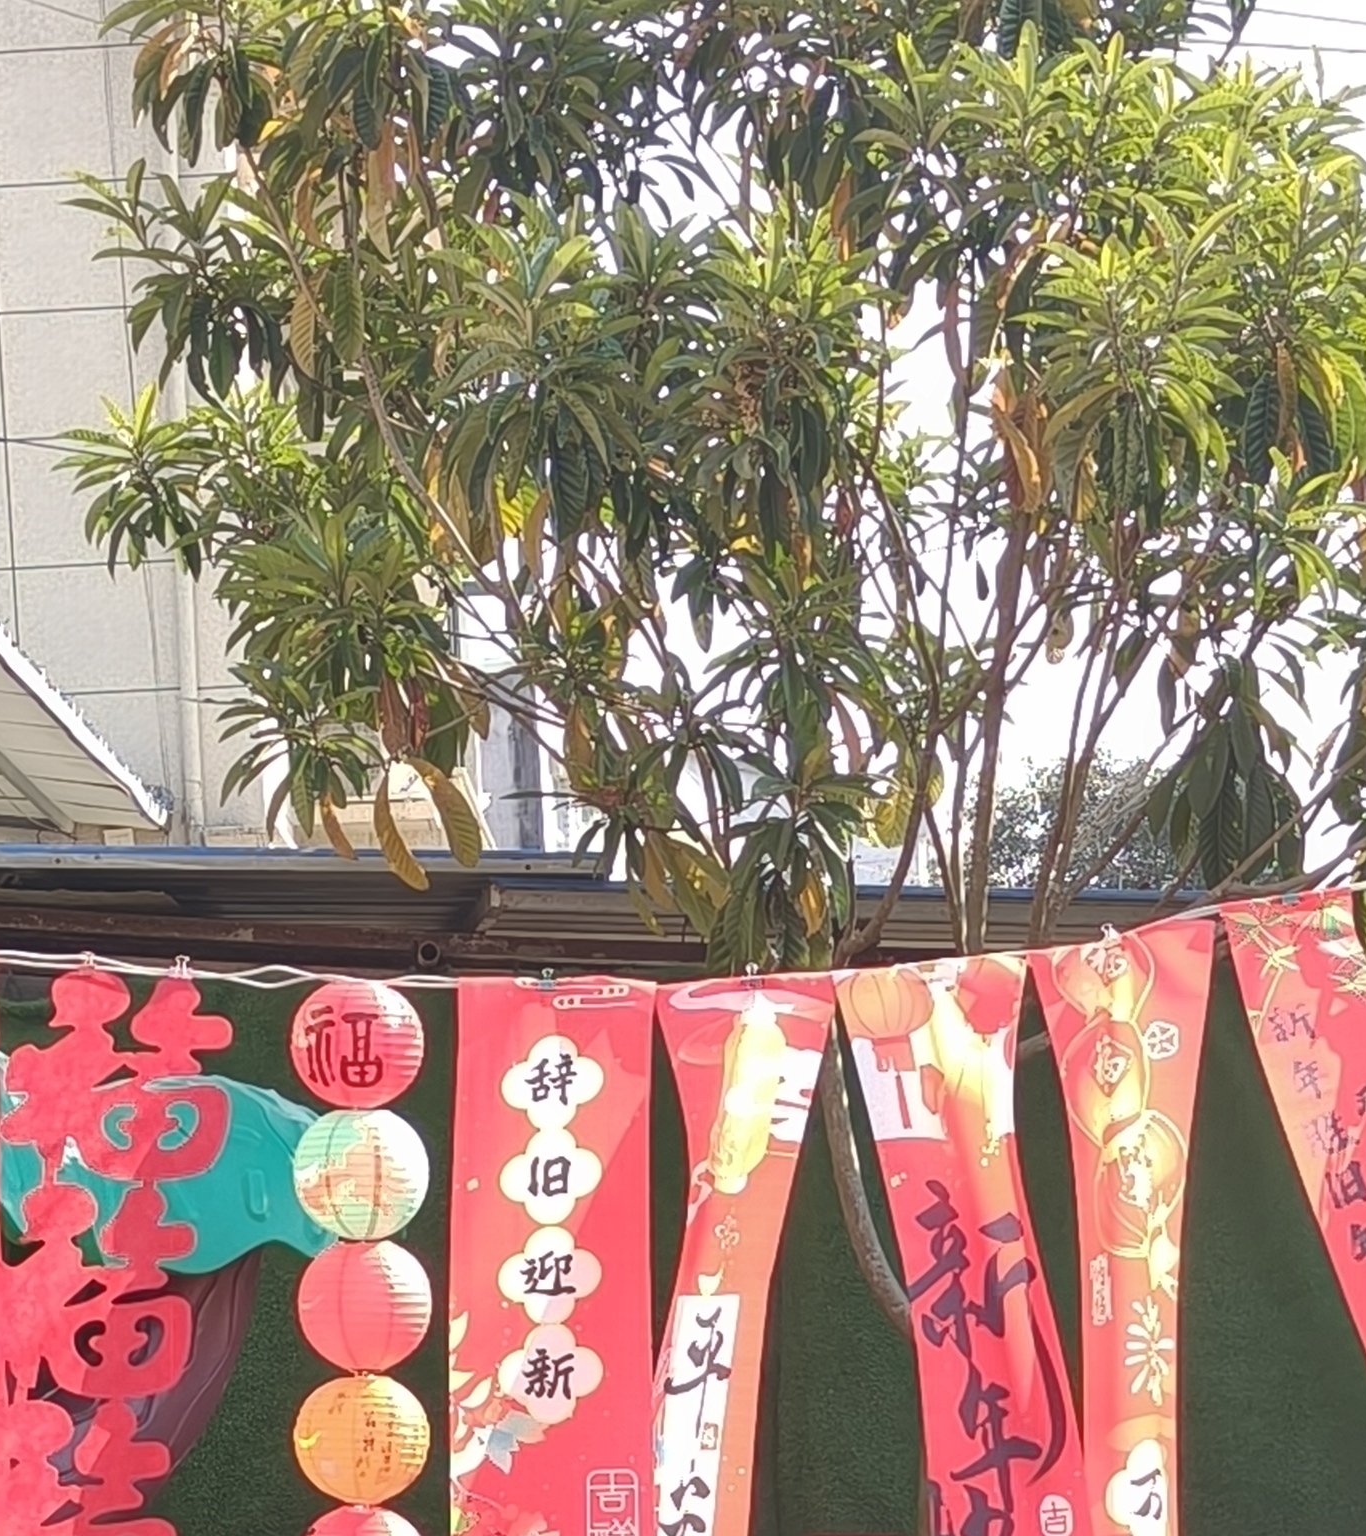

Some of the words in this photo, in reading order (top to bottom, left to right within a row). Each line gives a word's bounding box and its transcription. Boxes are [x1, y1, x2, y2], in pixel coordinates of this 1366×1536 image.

[521, 1052, 578, 1400] 辞旧迎新
[1041, 1499, 1072, 1536] 吉
